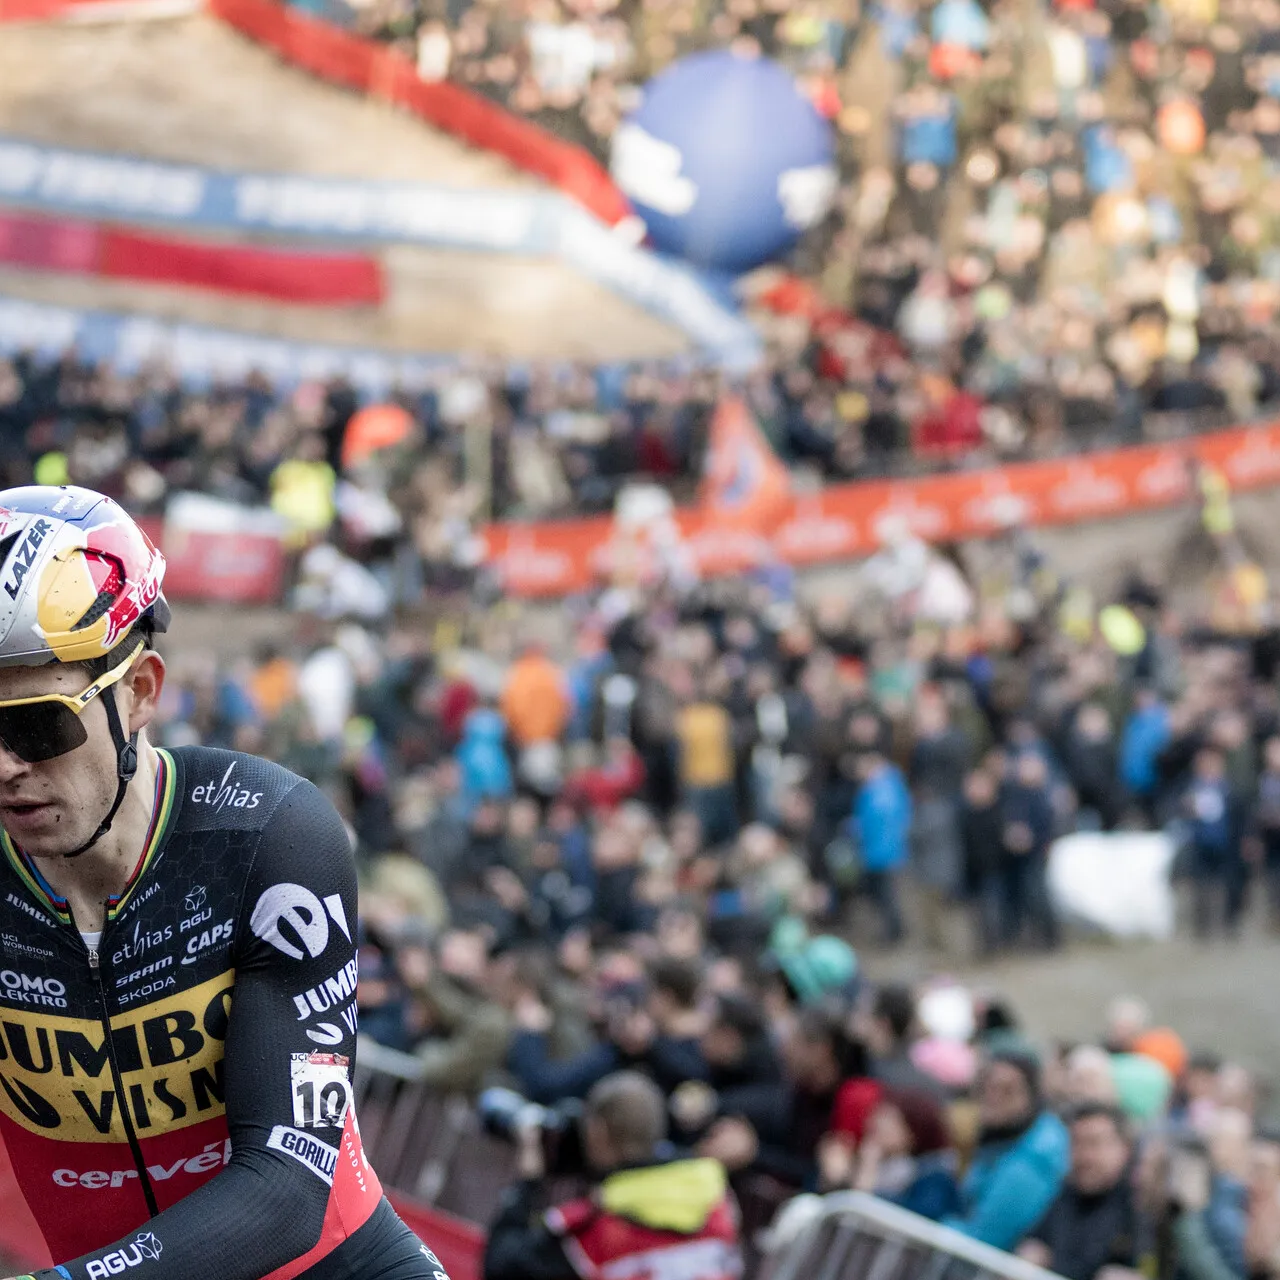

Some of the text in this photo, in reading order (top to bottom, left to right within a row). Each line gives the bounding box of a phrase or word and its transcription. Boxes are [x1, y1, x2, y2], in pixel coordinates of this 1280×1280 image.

[2, 518, 52, 601] LAZER
[192, 761, 264, 814] ethias
[130, 882, 161, 912] VISMA
[180, 907, 212, 932] AGU
[186, 919, 234, 954] CAPS
[1, 933, 18, 942] UCI
[2, 940, 54, 957] WORLDTOUR
[112, 921, 173, 965] ethias
[116, 955, 173, 988] SRAM
[293, 949, 359, 1021] JUMB
[52, 1138, 232, 1189] cervél
[344, 1132, 358, 1168] CARD
